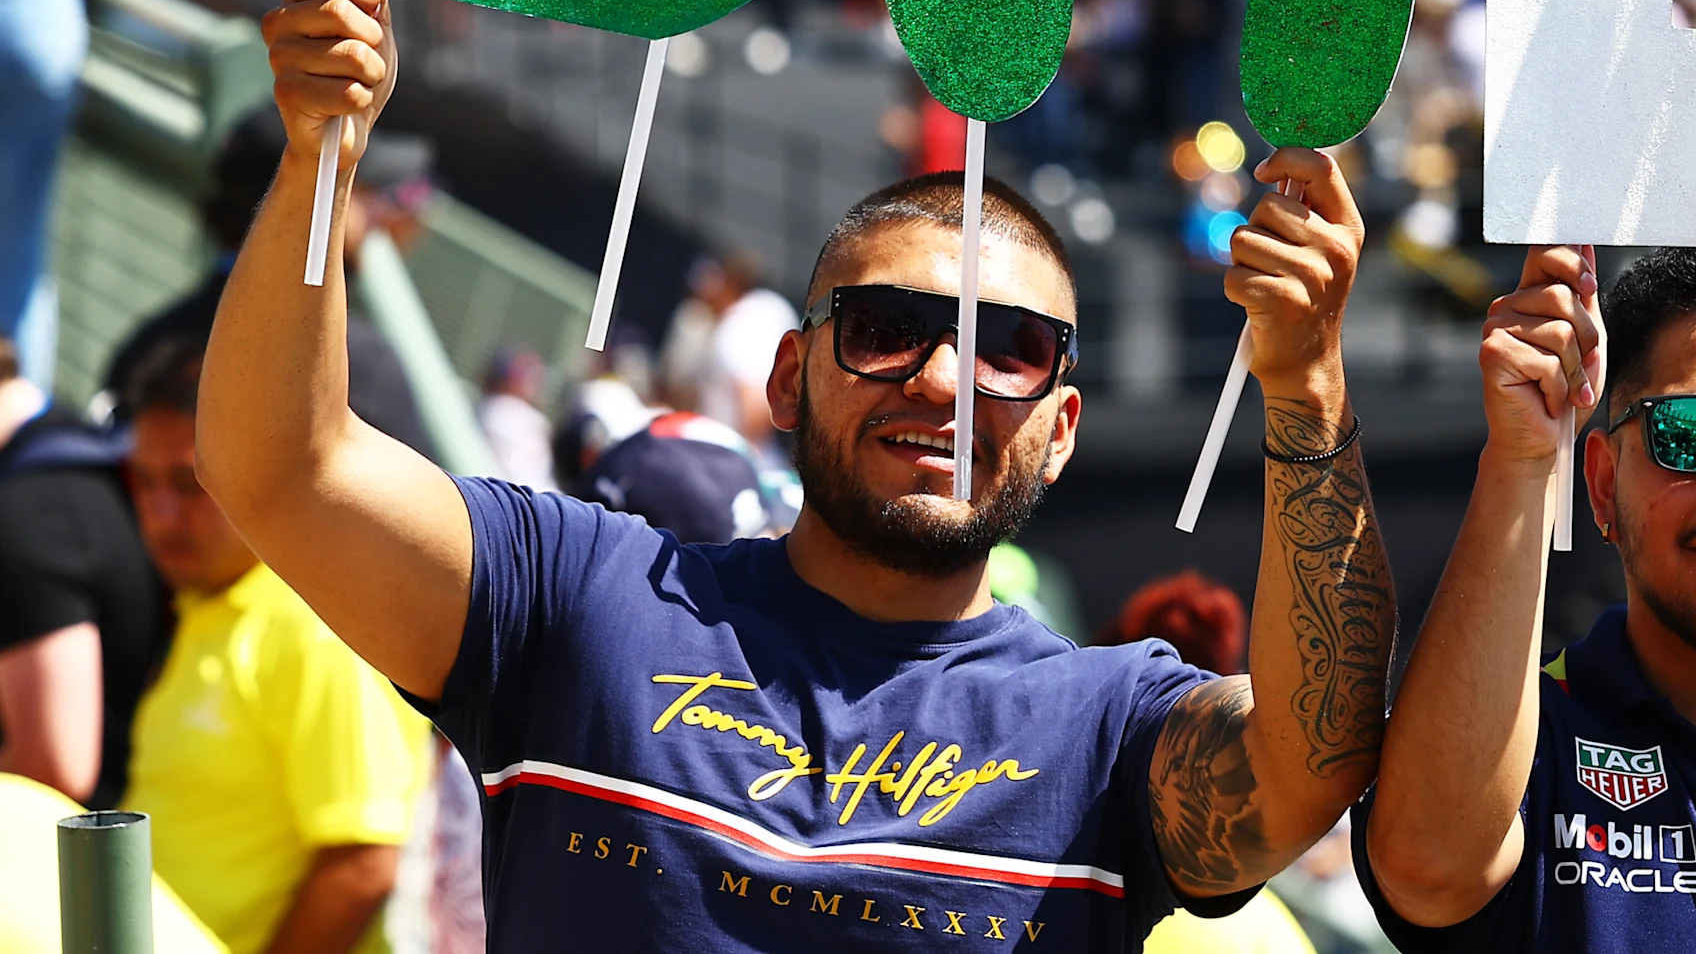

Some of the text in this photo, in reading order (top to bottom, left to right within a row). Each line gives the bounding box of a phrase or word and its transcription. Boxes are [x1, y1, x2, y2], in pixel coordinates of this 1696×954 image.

[652, 672, 1040, 827] Tommy Hilfiger
[1581, 745, 1656, 773] TAG
[1581, 768, 1663, 806] HEUER
[1554, 814, 1653, 861] Mobil
[566, 831, 1046, 944] EST. MCMLXXXV
